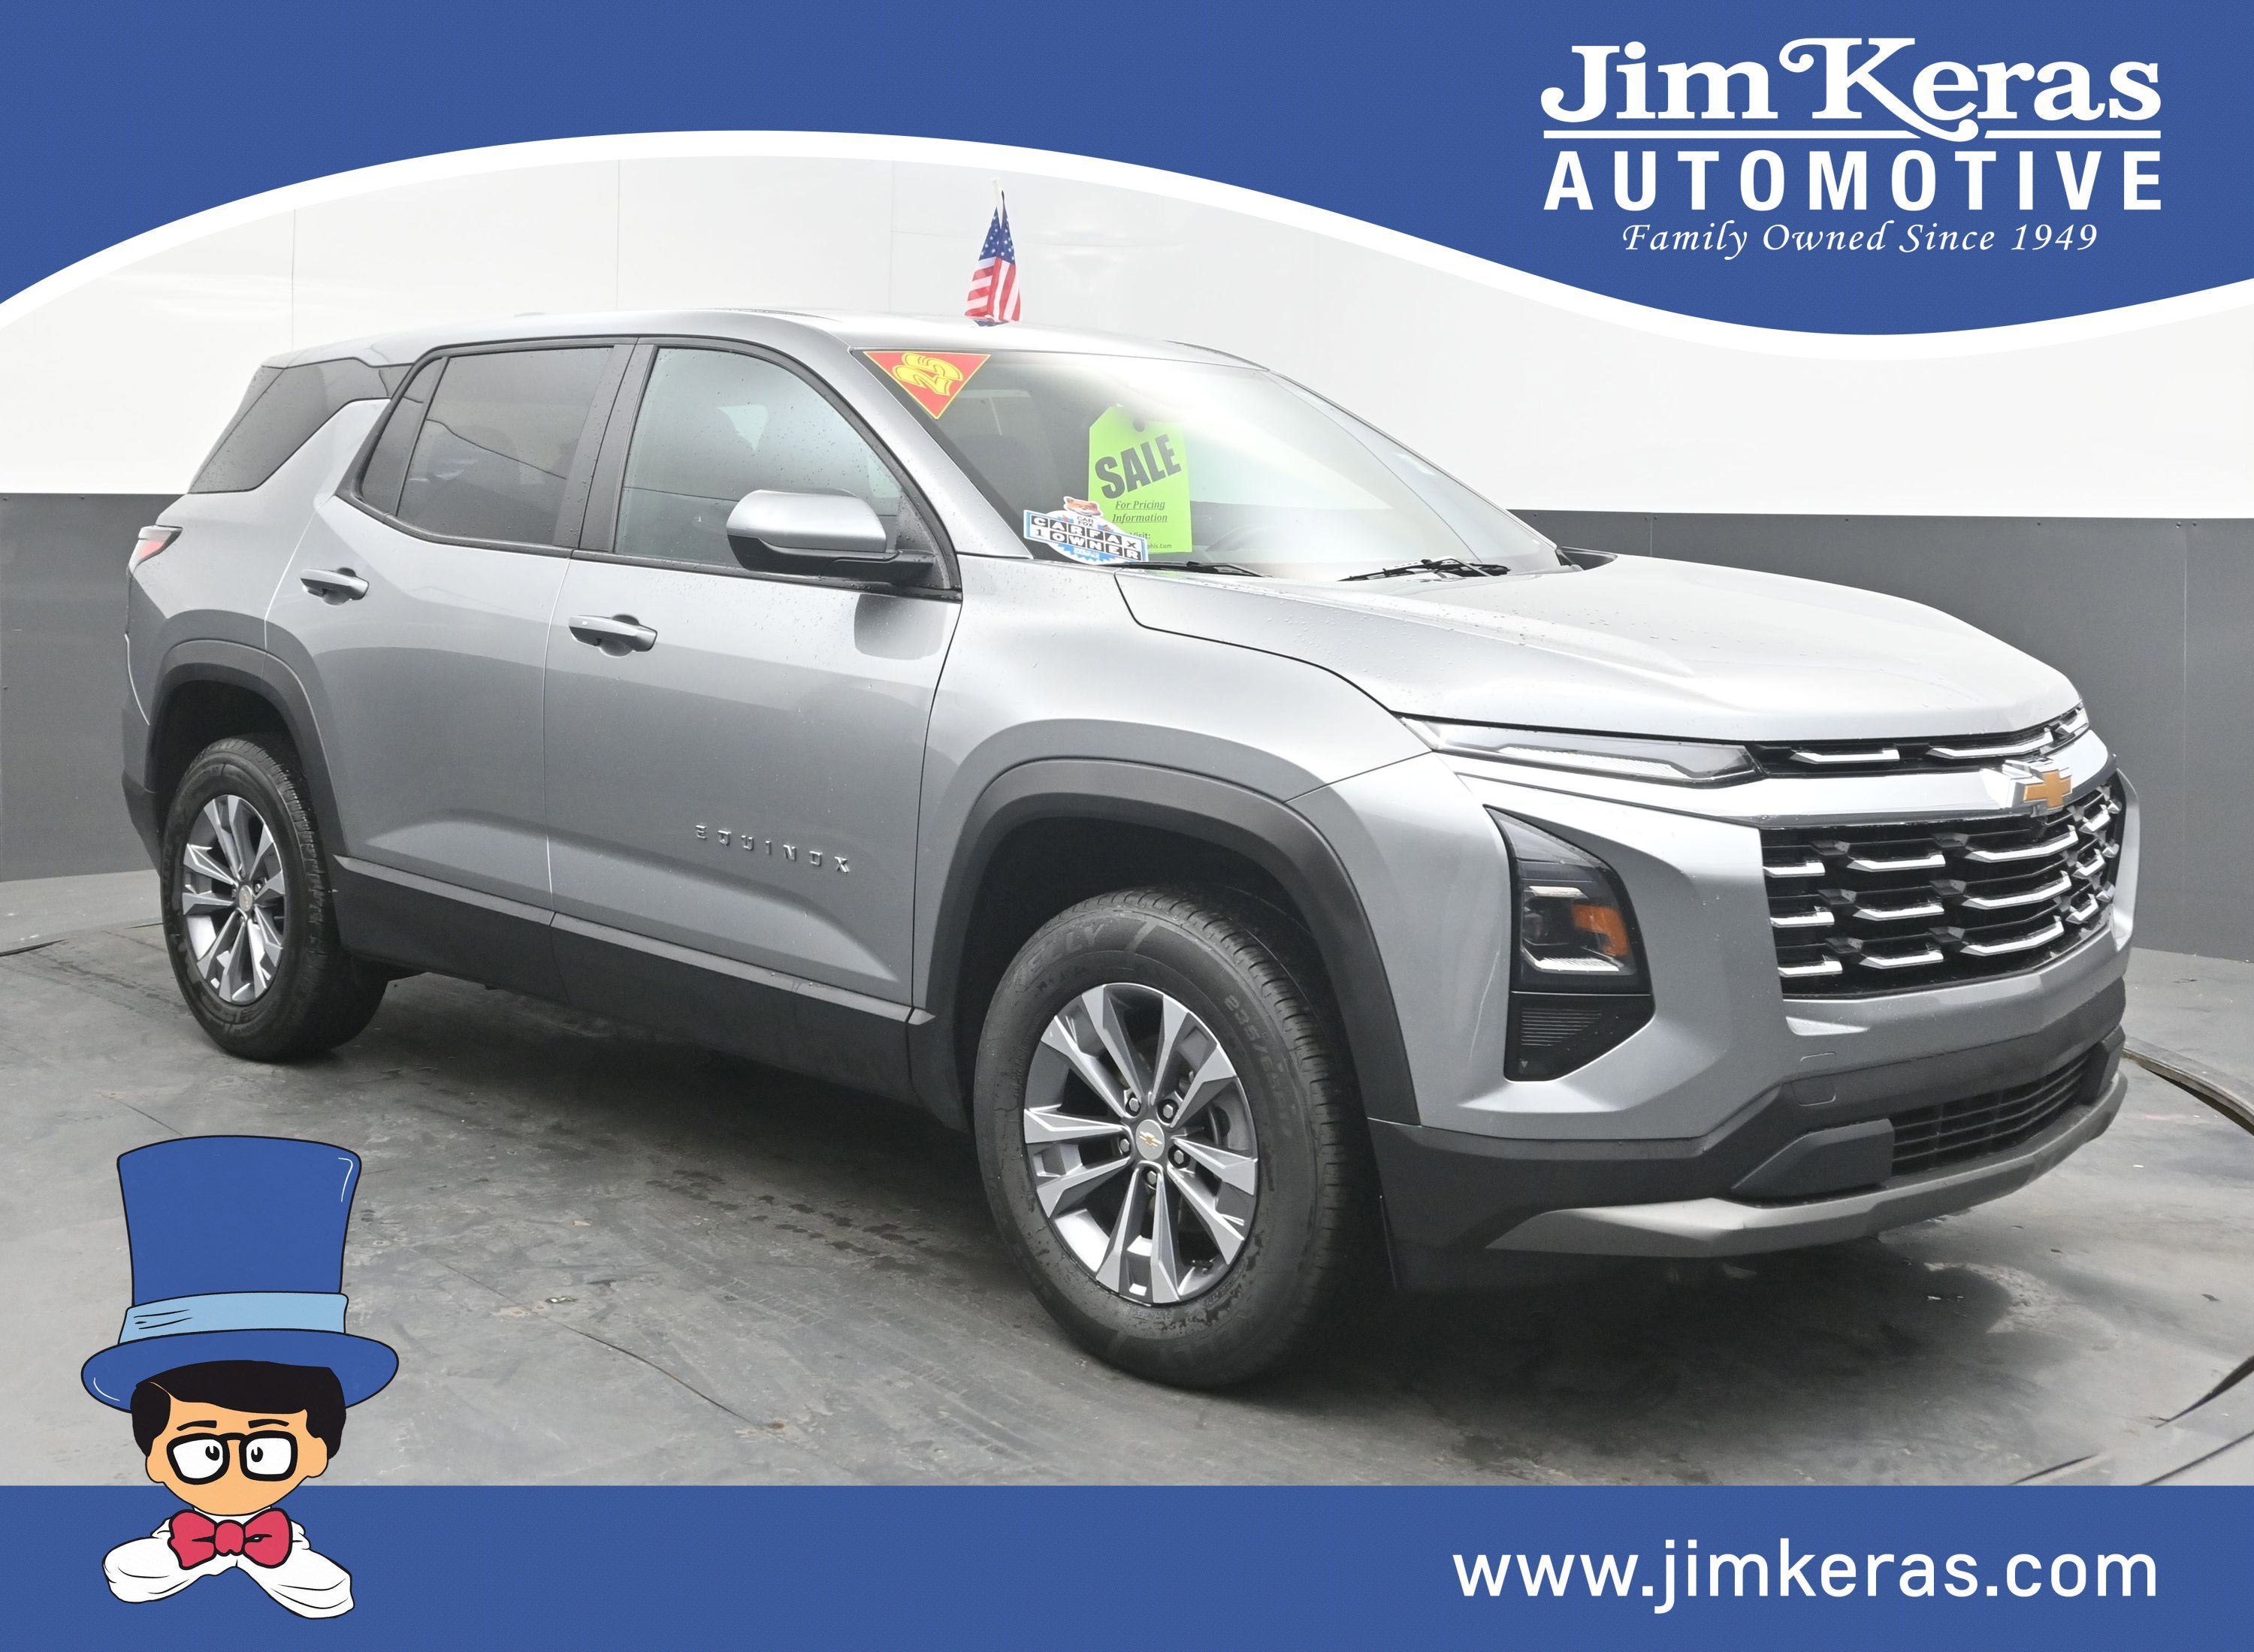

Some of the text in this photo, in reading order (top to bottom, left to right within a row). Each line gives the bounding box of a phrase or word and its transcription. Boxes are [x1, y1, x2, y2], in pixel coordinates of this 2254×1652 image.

[892, 352, 964, 396] 25
[1094, 433, 1183, 499] SALE
[1112, 514, 1168, 524] Information
[1115, 500, 1165, 510] For Pricing
[1032, 516, 1138, 549] CARFAX
[1035, 528, 1043, 536] 1
[1052, 533, 1139, 560] OWNER
[695, 824, 850, 873] EQUINOX
